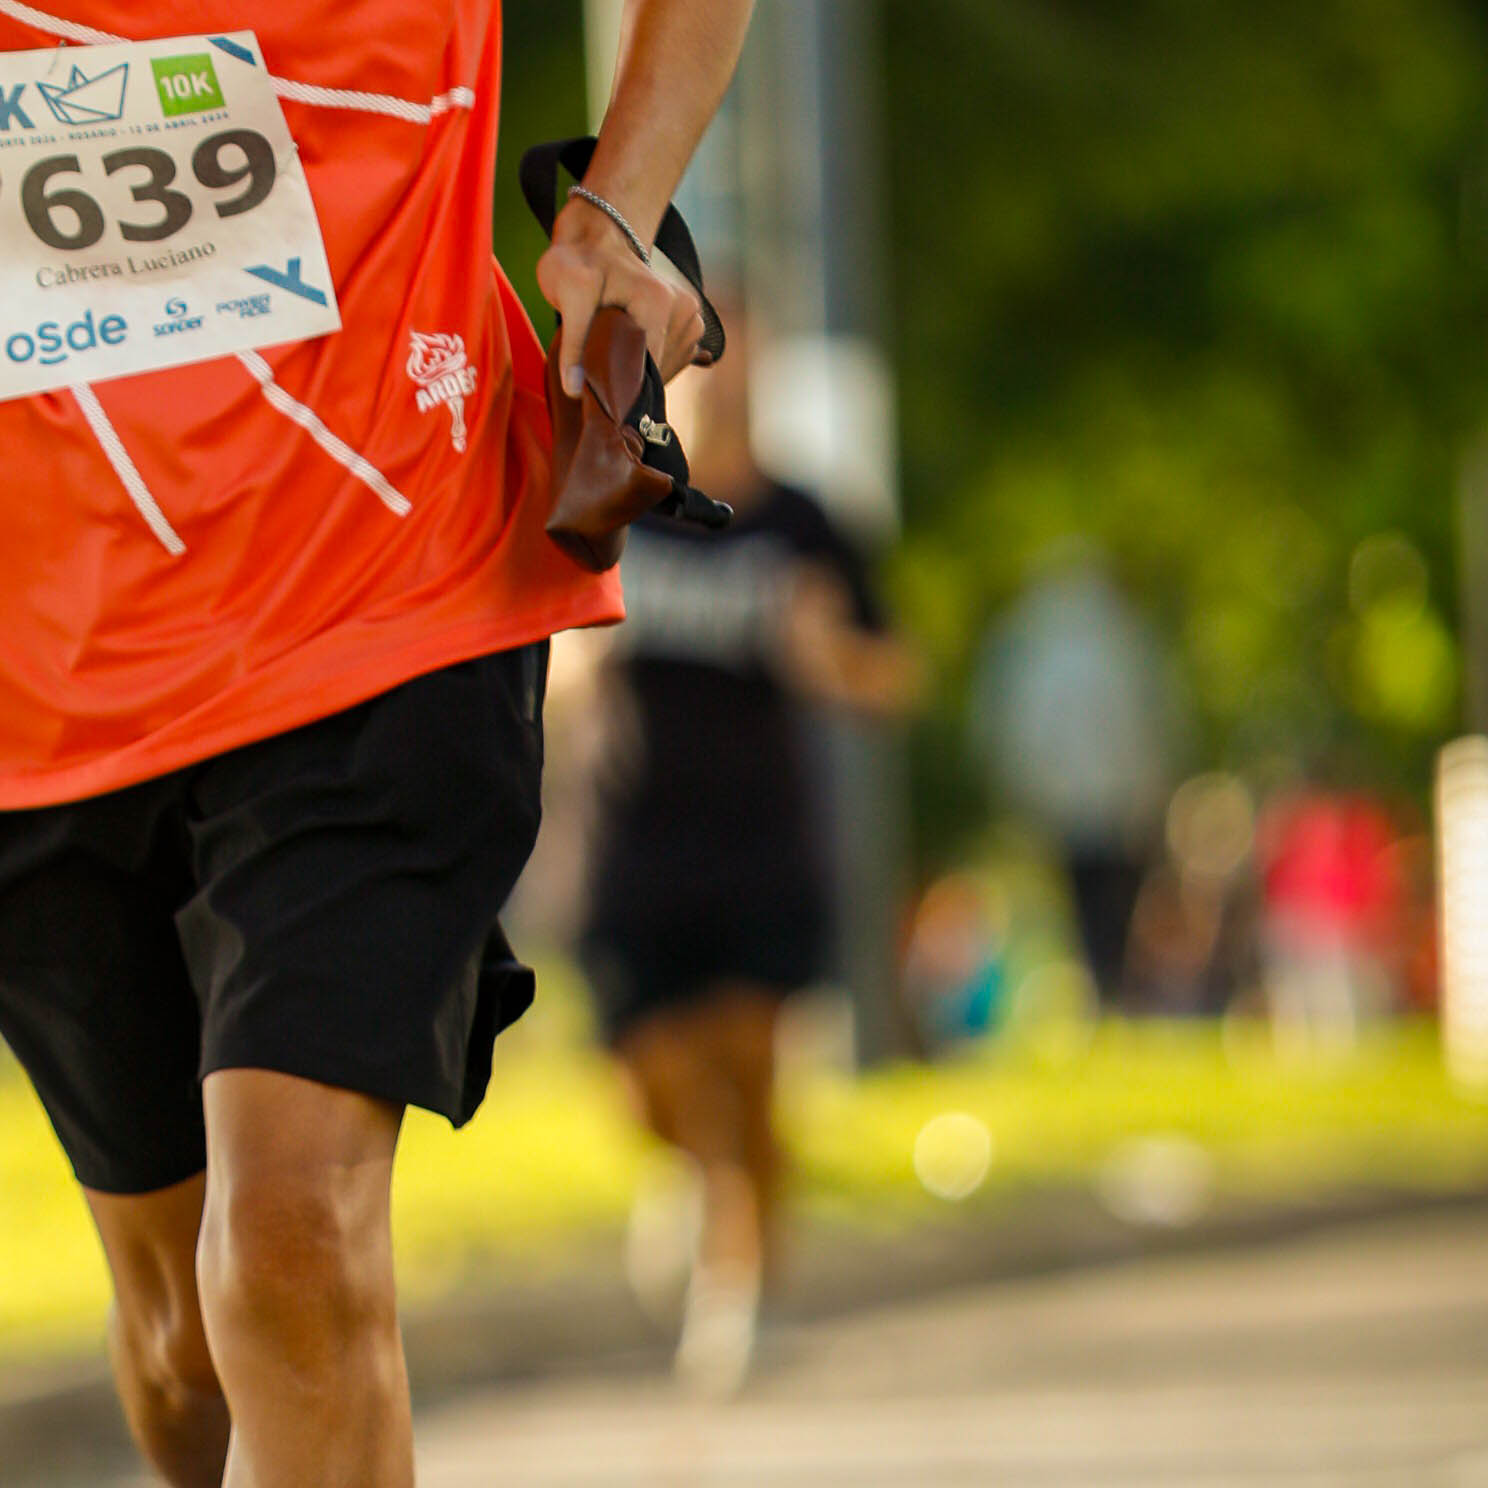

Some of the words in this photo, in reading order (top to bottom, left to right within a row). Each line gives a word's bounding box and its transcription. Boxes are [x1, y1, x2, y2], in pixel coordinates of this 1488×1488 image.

[159, 69, 214, 100] 10K
[35, 252, 124, 290] Cabrera
[126, 240, 217, 275] Luciano
[5, 308, 128, 363] osde
